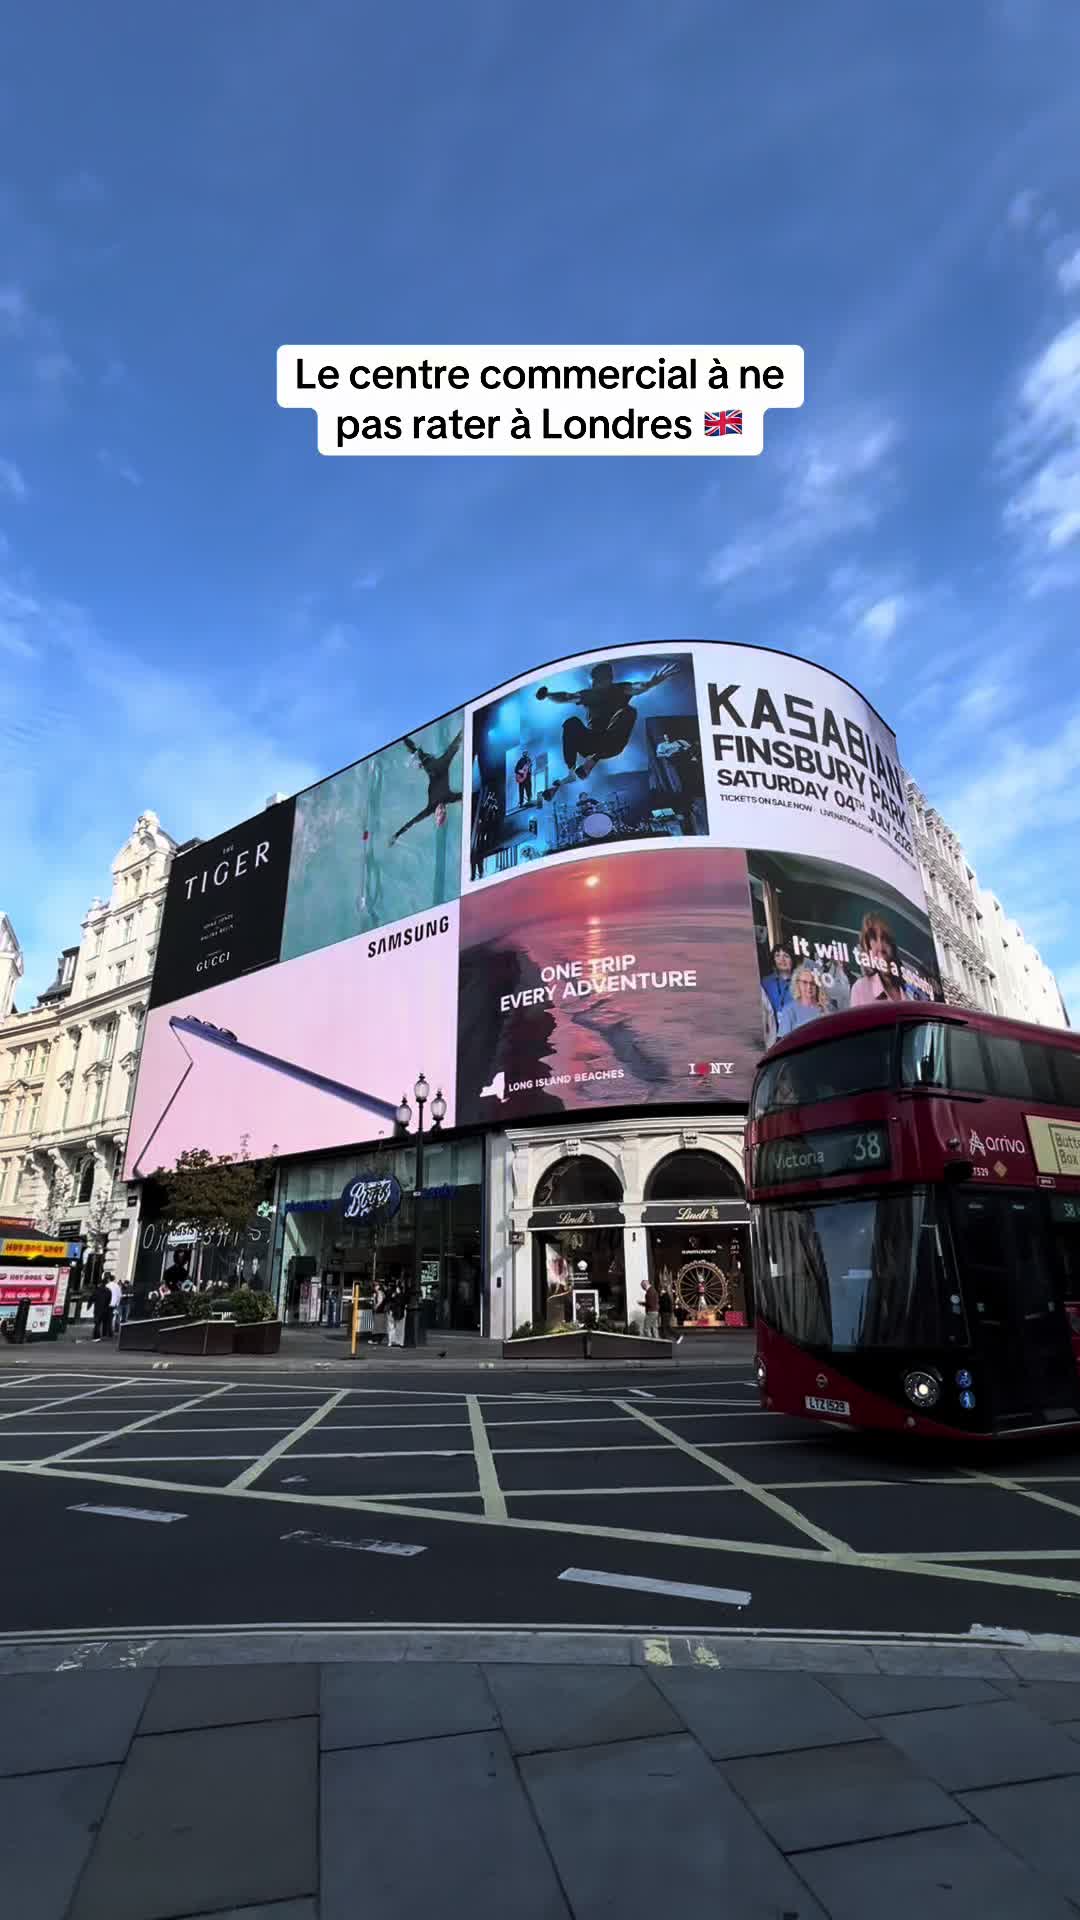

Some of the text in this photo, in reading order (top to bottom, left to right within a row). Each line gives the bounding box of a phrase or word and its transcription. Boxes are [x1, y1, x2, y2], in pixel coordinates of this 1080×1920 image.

[707, 682, 905, 804] KASABIAN
[712, 733, 910, 836] FINSBURY PARK
[717, 768, 829, 801] SATURDAY
[834, 790, 866, 812] 04TH
[867, 807, 891, 836] JULY
[719, 793, 757, 804] TICKETS
[758, 796, 772, 805] ON
[772, 798, 793, 809] SALE
[793, 801, 813, 812] NOW
[184, 840, 270, 900] TIGER
[367, 914, 450, 959] SAMSUNG
[196, 951, 230, 973] GUCCI
[540, 954, 636, 983] ONE TRIP
[792, 935, 900, 977] It will take a
[500, 969, 697, 1013] EVERY ADVENTURE
[508, 1068, 625, 1093] LONG ISLAND BEACHES
[688, 1062, 735, 1075] I NY
[774, 1149, 825, 1169] Victoria
[853, 1130, 881, 1161] 38
[985, 1135, 1025, 1154] arriva
[344, 1179, 392, 1218] Boots
[675, 1206, 709, 1220] Lindt
[557, 1212, 585, 1224] Lindt
